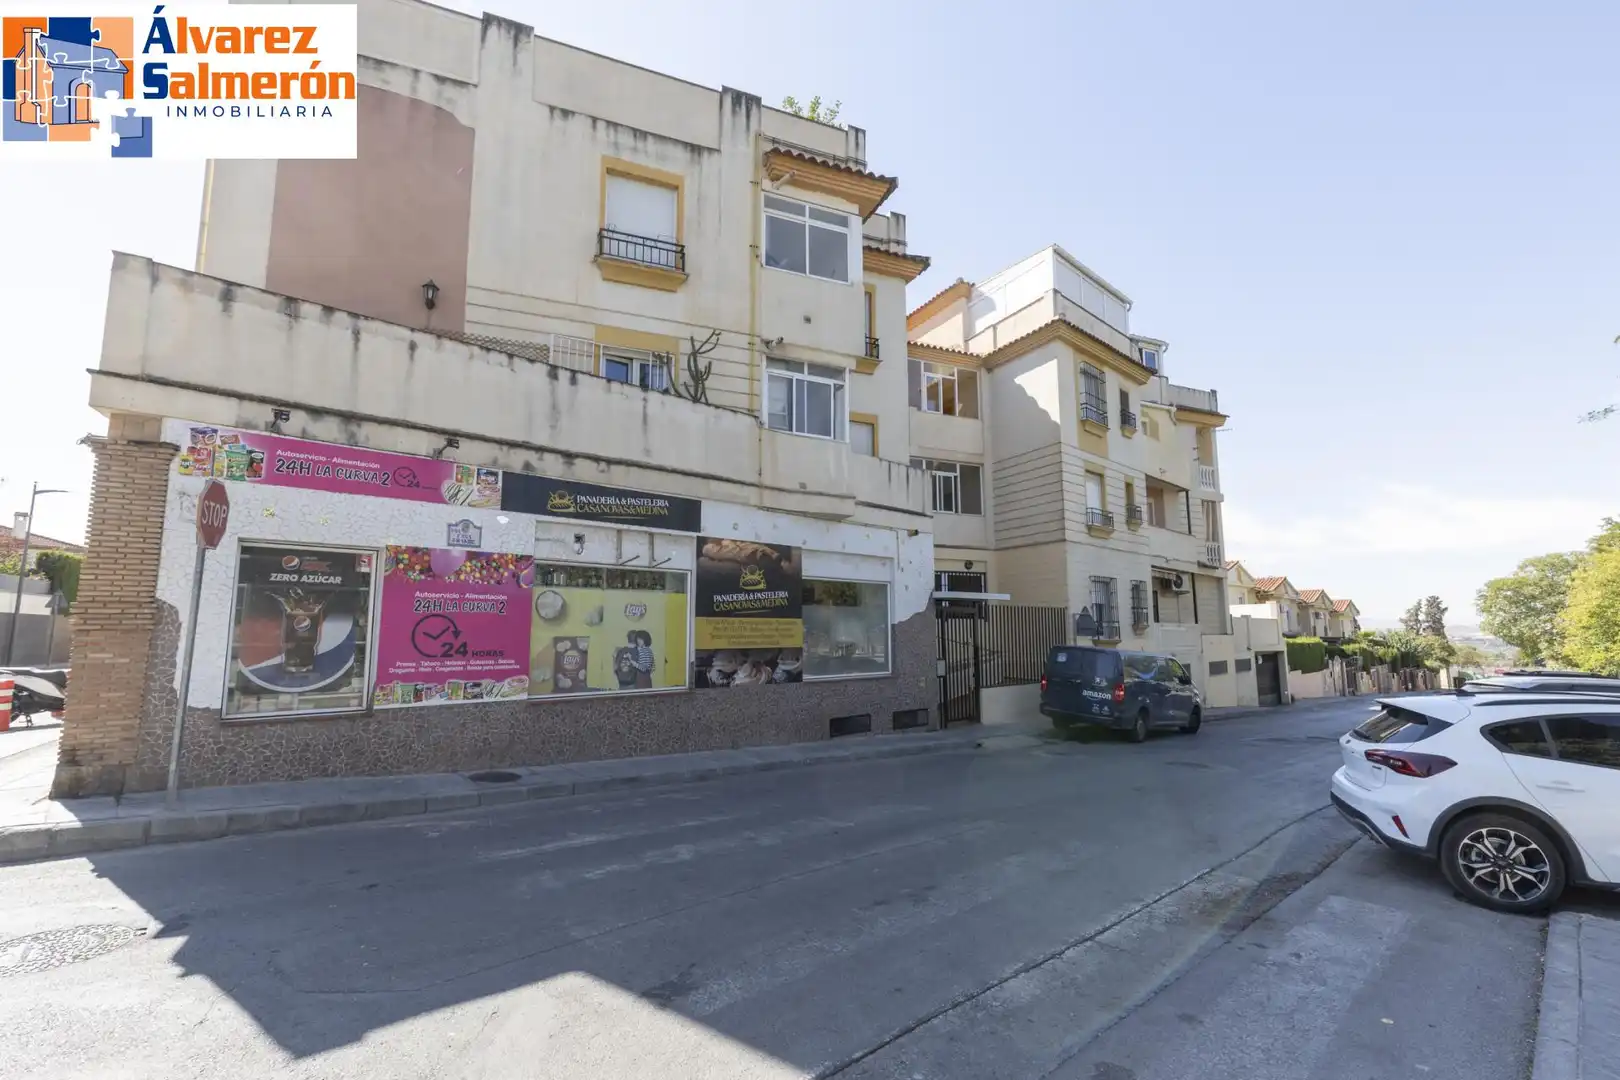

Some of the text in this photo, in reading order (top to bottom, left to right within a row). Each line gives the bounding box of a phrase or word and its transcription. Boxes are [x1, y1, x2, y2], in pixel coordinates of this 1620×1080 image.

[276, 449, 327, 462] Autoservicio
[332, 456, 380, 469] Alimentación
[274, 458, 392, 487] 24H LA CURVA 2
[406, 479, 420, 489] 24
[201, 500, 228, 528] STOP
[269, 572, 342, 585] ZERO AZÚCAR
[414, 590, 460, 600] Autoservicio
[464, 592, 508, 601] Alimentación
[413, 599, 507, 615] 24H LA CURVA 2
[440, 641, 505, 658] 24 HORAS
[1081, 689, 1112, 701] amazon
